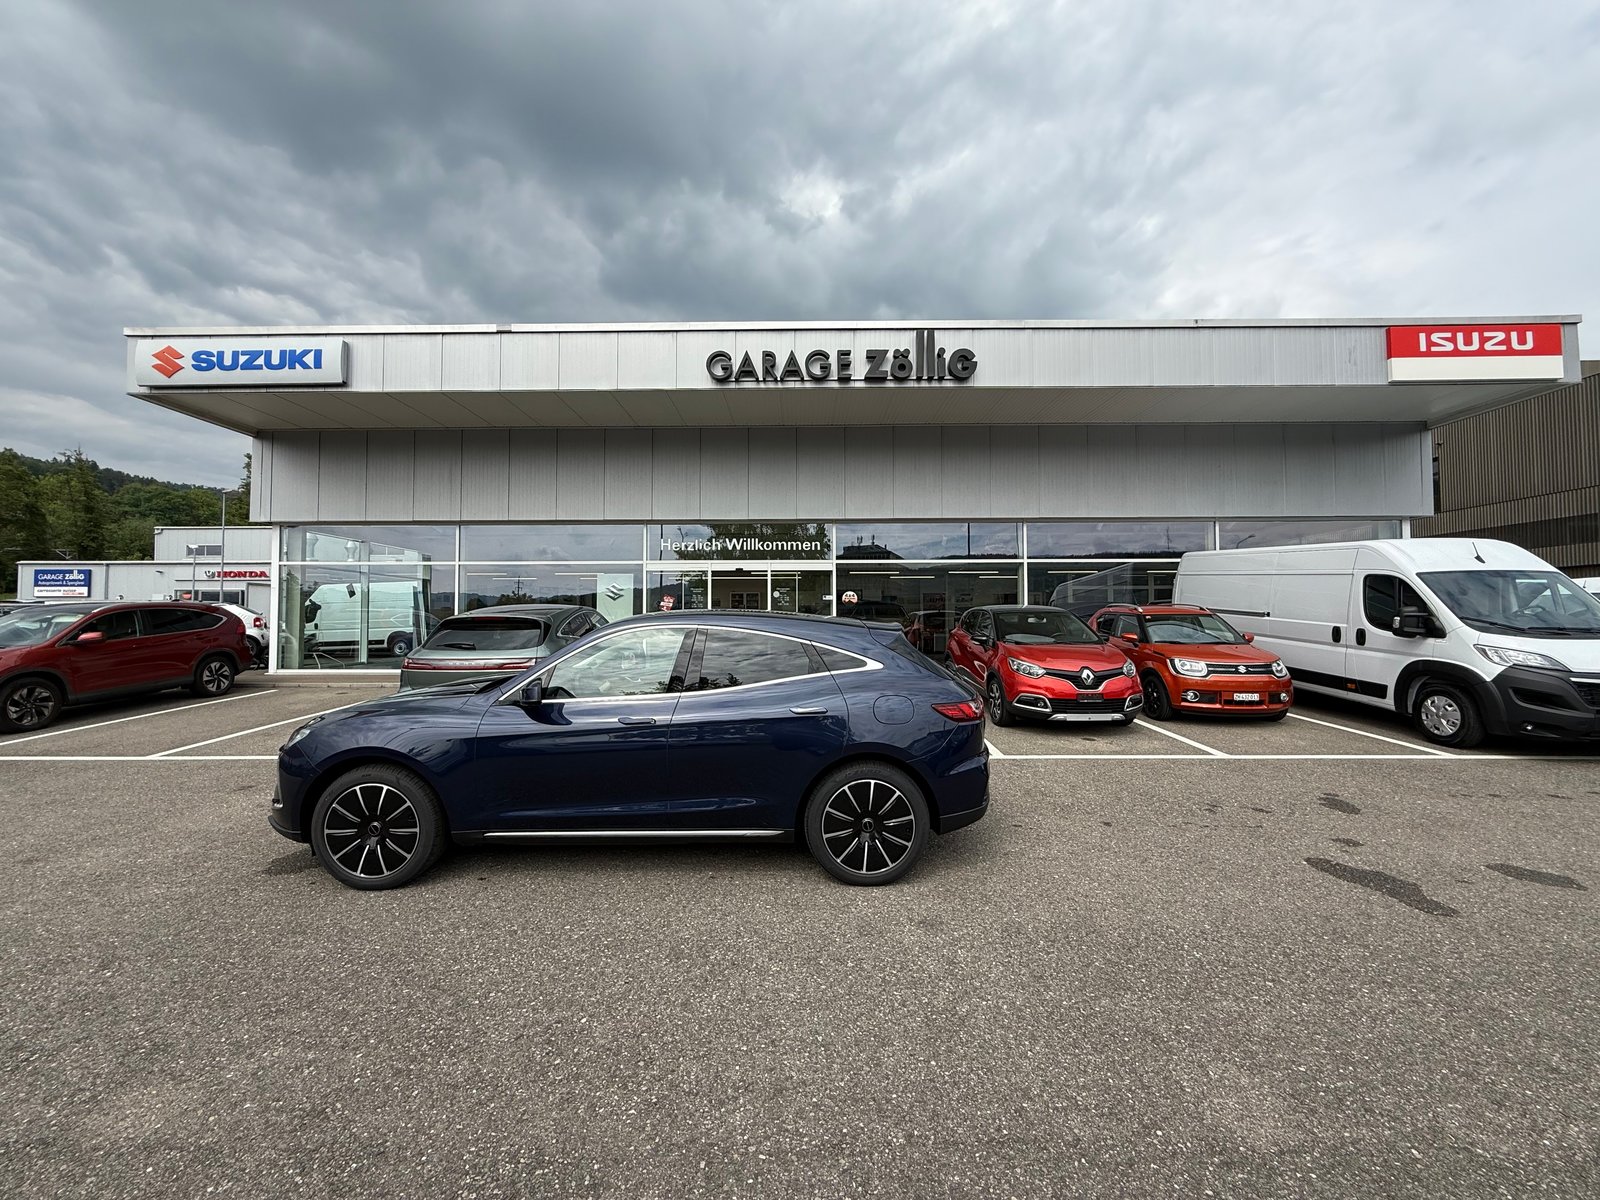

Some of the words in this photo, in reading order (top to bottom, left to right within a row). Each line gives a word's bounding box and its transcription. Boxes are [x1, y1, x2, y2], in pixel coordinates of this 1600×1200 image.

[1419, 331, 1533, 352] ISUZU
[191, 349, 323, 371] SUZUKI
[706, 350, 852, 382] GARAGE
[661, 538, 721, 551] Herzlich
[726, 538, 820, 551] Willkommen
